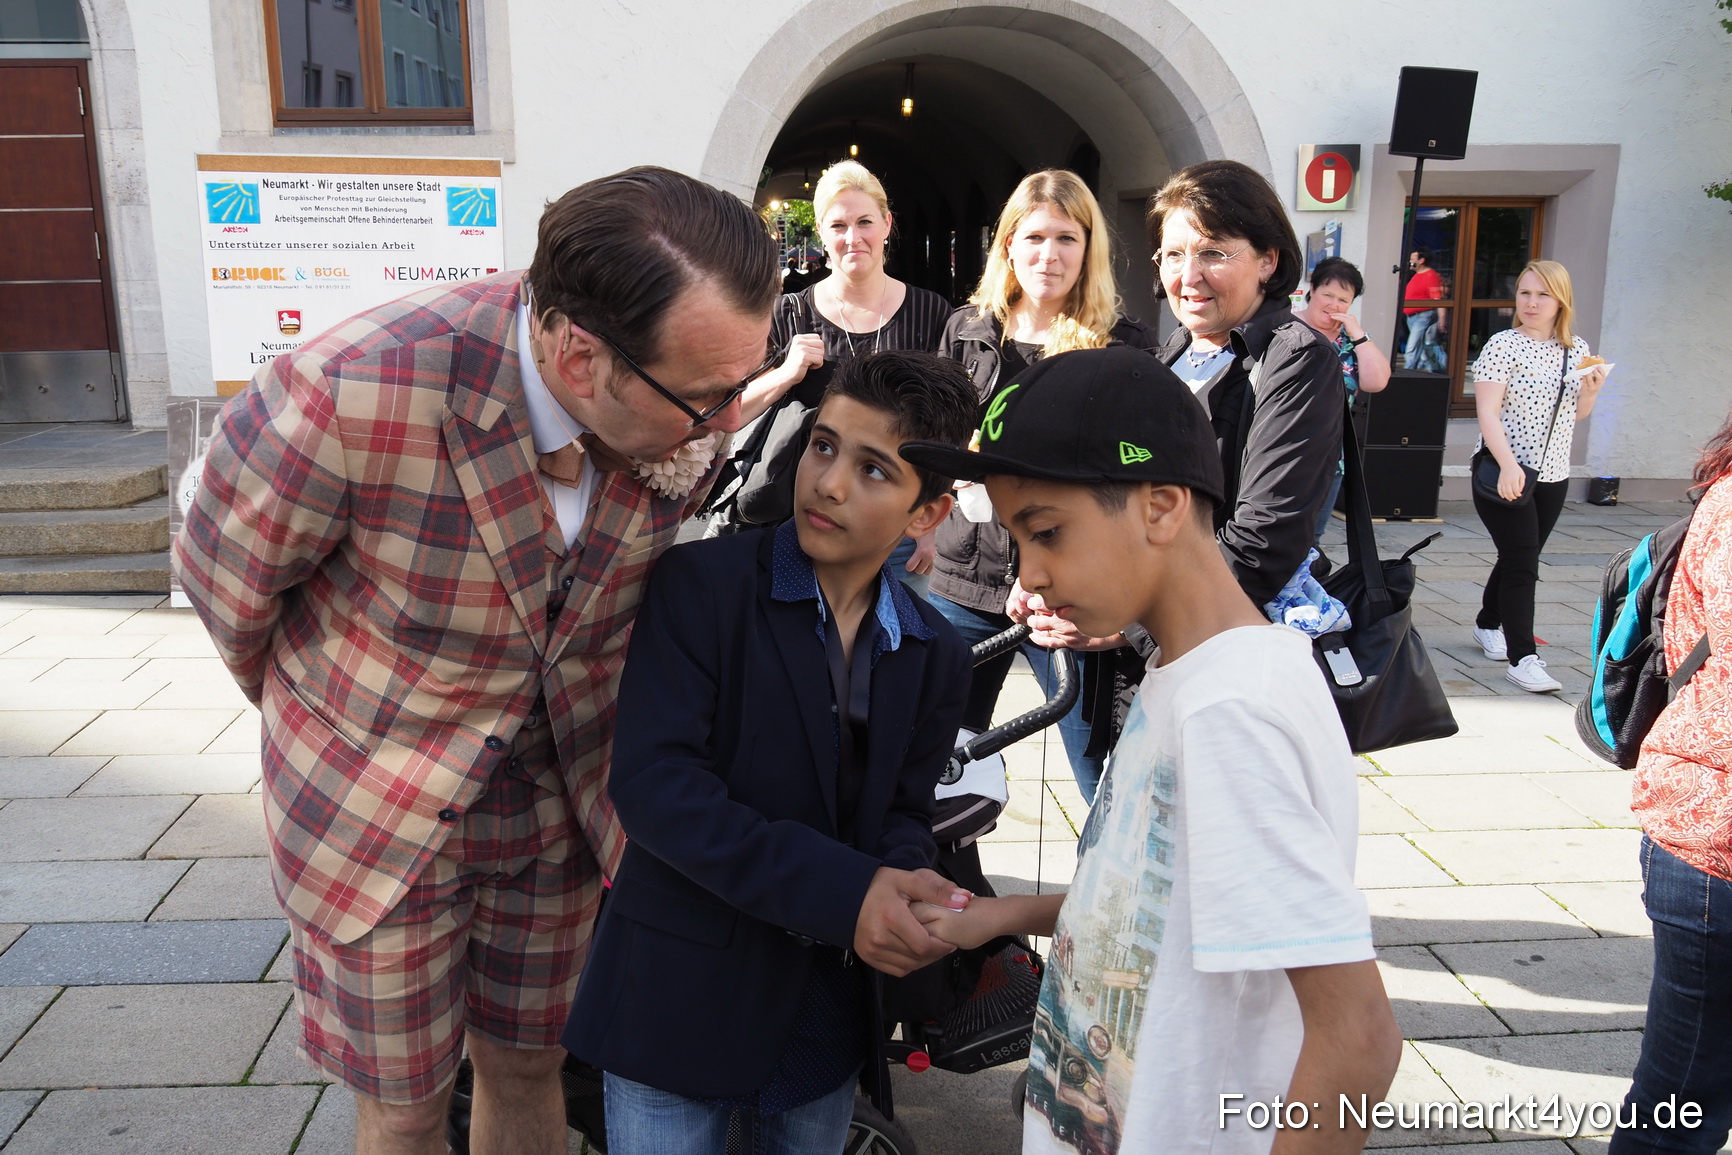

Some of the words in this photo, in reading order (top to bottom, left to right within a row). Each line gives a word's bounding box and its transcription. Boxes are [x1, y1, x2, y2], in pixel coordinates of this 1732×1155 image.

[262, 178, 309, 190] Neumarkt
[317, 180, 334, 190] Wir
[336, 180, 380, 192] gestalten
[382, 182, 414, 192] unsere
[416, 181, 441, 192] Stadt
[279, 194, 325, 204] Europäischer
[326, 196, 364, 204] Protesttag
[378, 196, 426, 204] Gleichstellung
[364, 206, 408, 214] Behinderung
[274, 215, 346, 224] Arbeitsgemeinschaft
[348, 216, 370, 224] Offene
[372, 216, 434, 225] Behindertenarbeit
[209, 240, 282, 249] Unterstützer
[332, 241, 378, 250] sozialen
[381, 241, 415, 250] Arbeit
[314, 266, 350, 278] BÖGL
[384, 266, 480, 281] NEUMARKT
